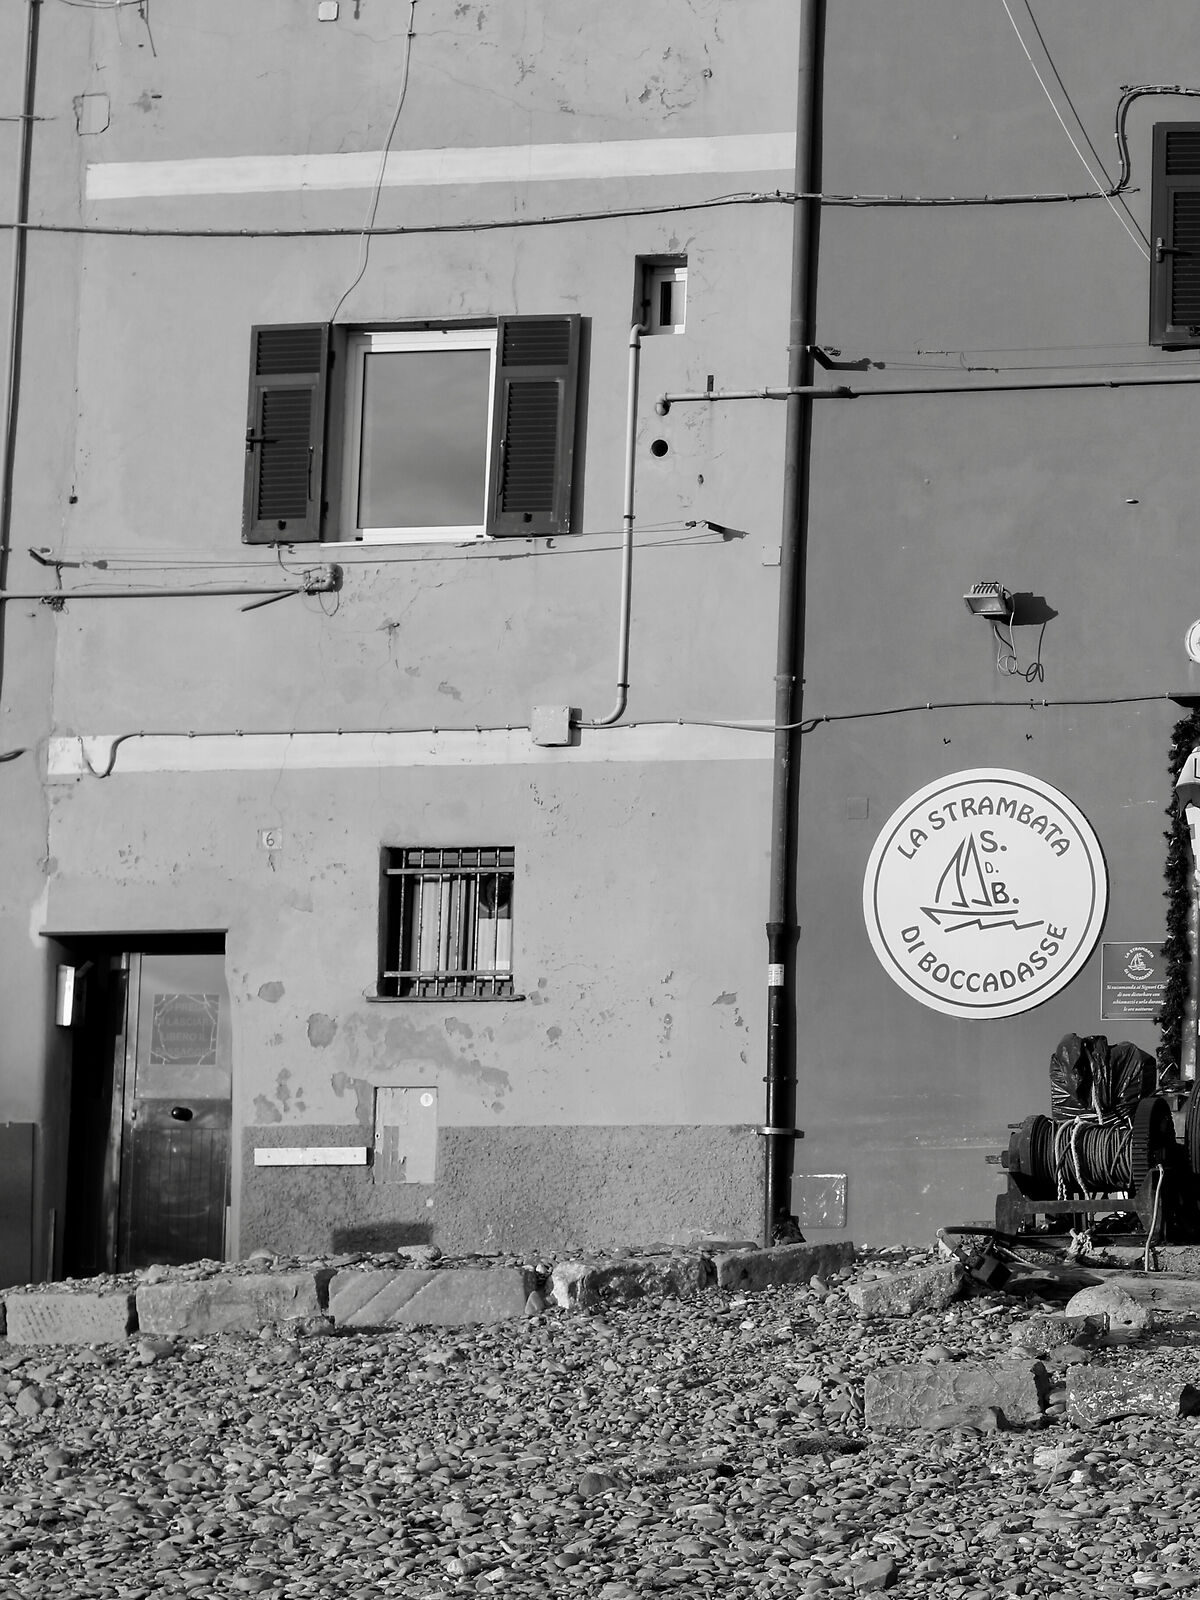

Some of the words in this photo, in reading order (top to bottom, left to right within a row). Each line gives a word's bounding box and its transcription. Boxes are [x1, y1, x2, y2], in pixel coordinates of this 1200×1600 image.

[266, 831, 275, 847] 6
[897, 828, 929, 860] LA
[928, 796, 1071, 857] STRAMBATA
[979, 830, 1007, 853] S.
[984, 861, 999, 874] D.
[991, 881, 1020, 904] B.
[900, 925, 925, 953] DI
[917, 923, 1068, 993] BOCCADASSE
